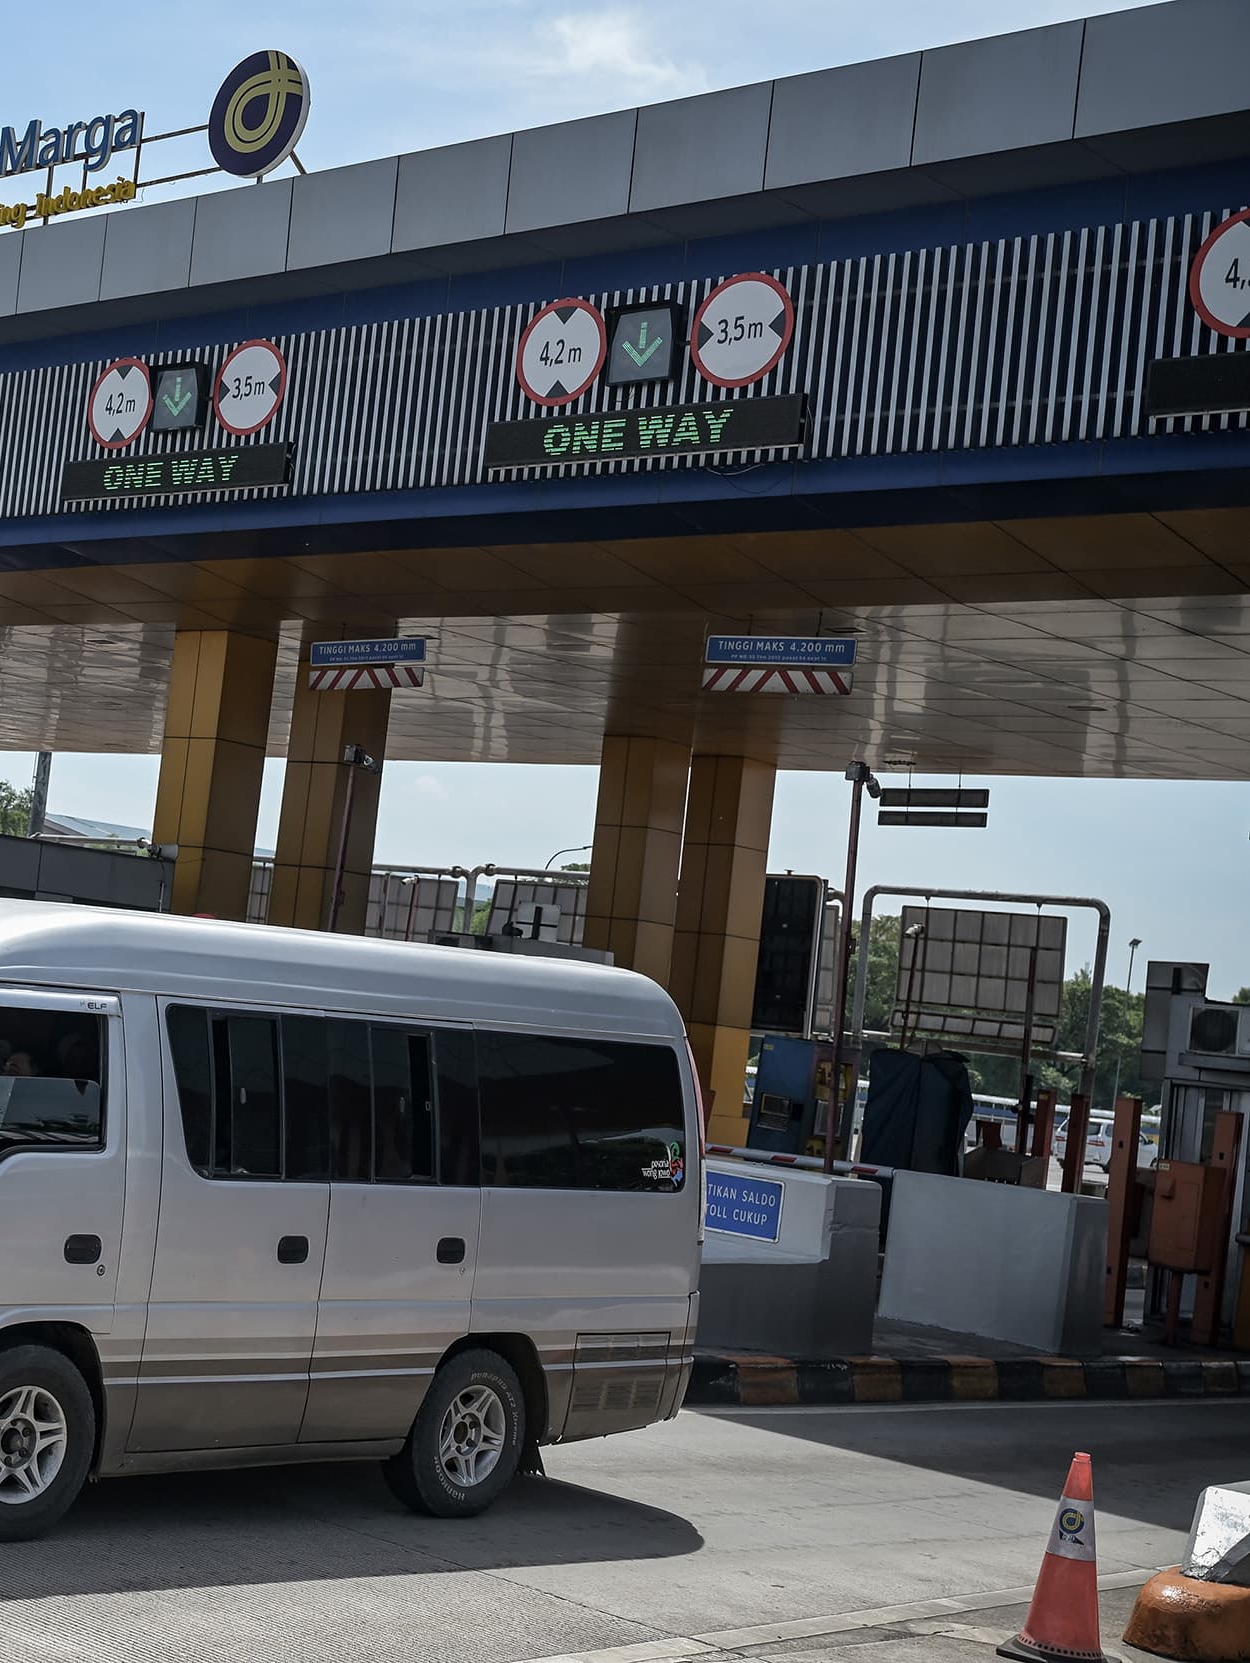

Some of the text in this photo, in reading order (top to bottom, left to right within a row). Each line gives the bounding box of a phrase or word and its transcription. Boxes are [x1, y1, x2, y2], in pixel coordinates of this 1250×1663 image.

[34, 176, 137, 217] Indonesia
[1225, 258, 1250, 290] 4,
[543, 408, 734, 455] ONE WAY
[102, 455, 239, 491] ONE WAY
[319, 646, 347, 655] TINGGI
[348, 644, 370, 654] MAKS
[400, 642, 416, 652] mm
[718, 640, 845, 653] TINGGI MAKS 4.200 mm
[87, 1002, 107, 1010] ELF
[708, 1183, 776, 1207] TIKAN SALDO
[733, 1208, 768, 1226] CUKUP
